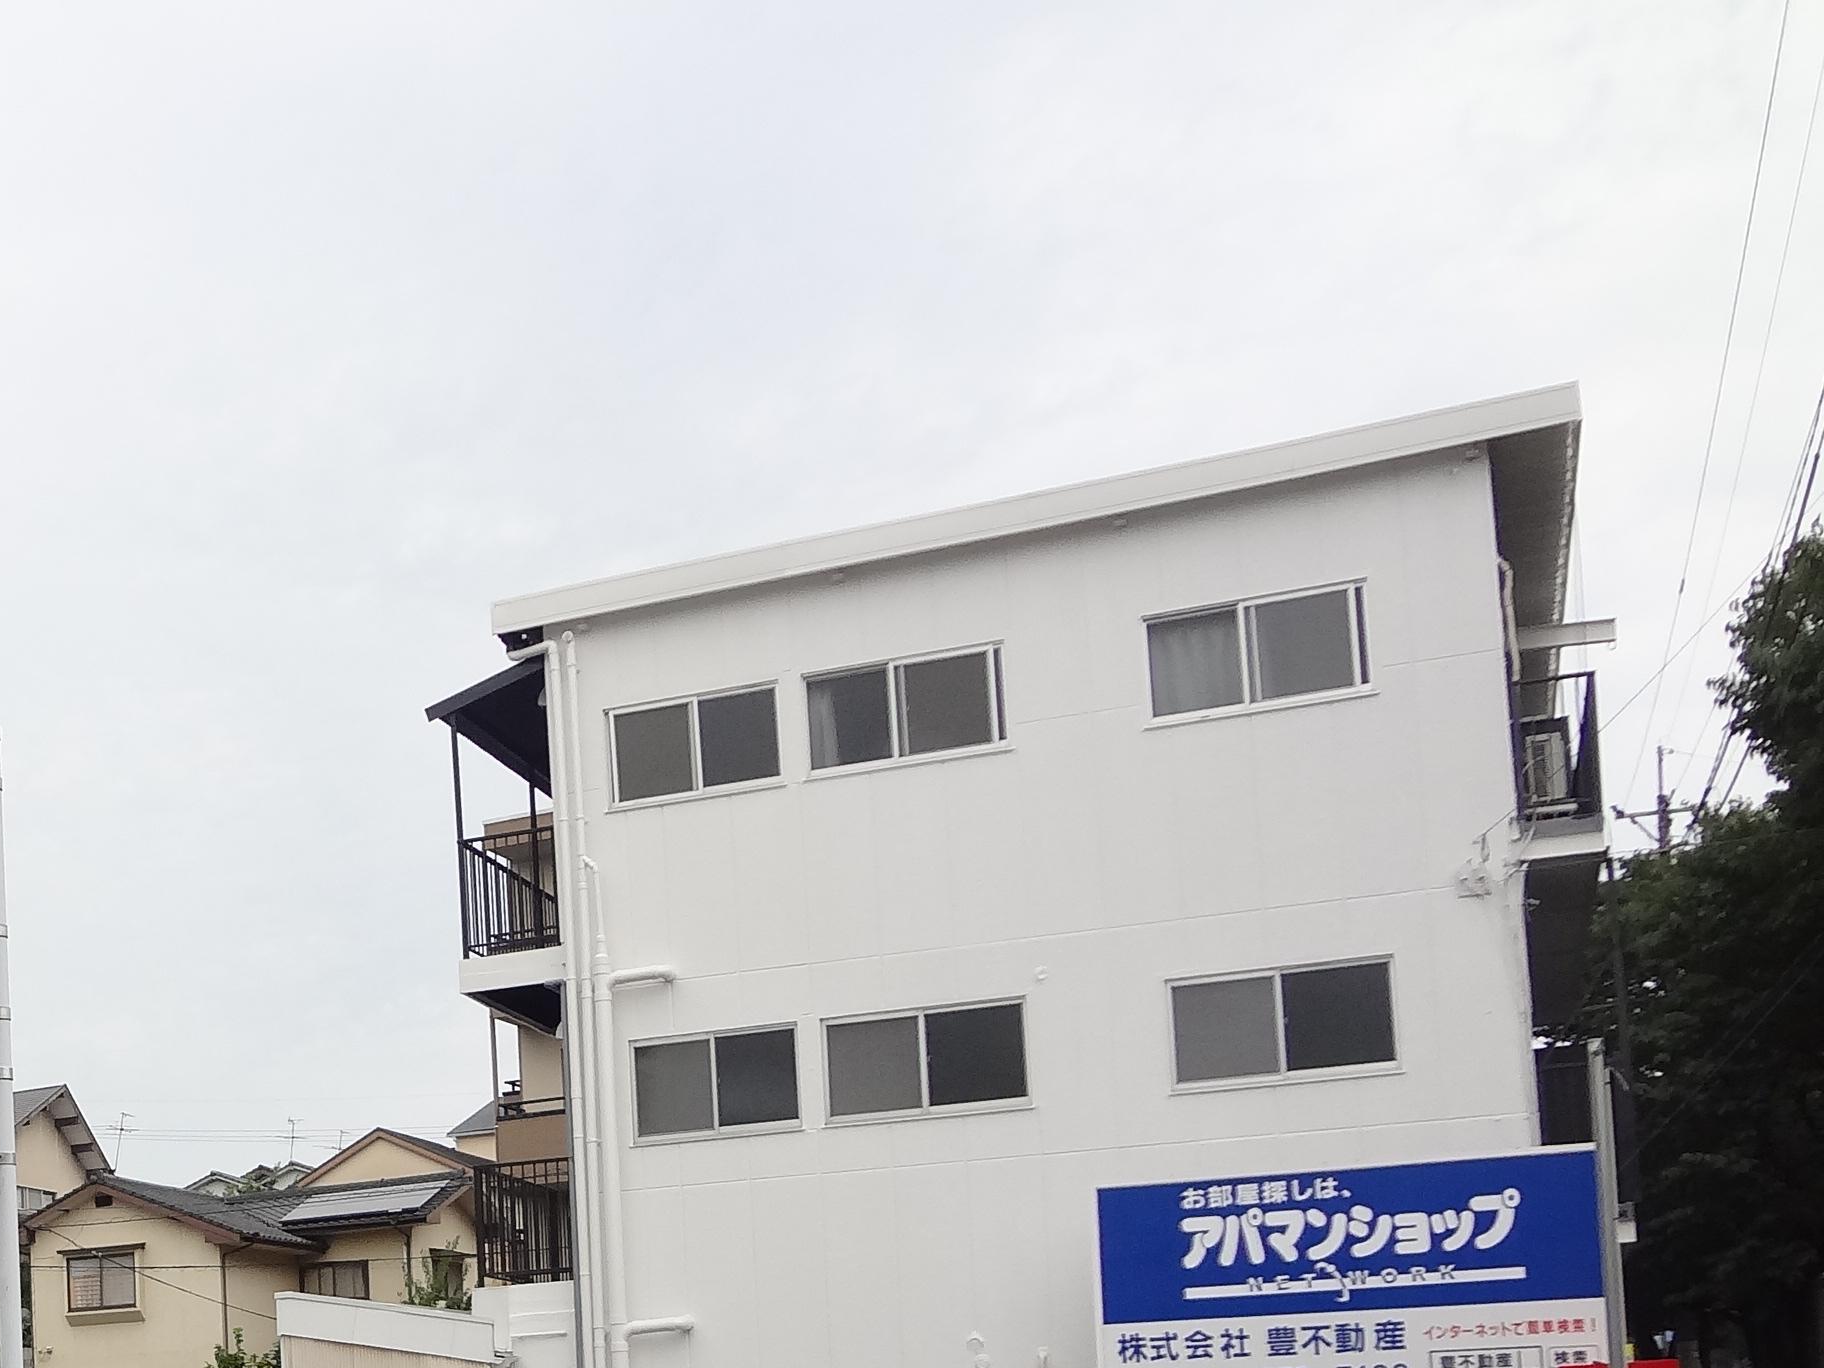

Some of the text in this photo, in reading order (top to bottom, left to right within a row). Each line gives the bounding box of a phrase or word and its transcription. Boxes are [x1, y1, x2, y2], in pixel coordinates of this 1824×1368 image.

[1178, 1187, 1522, 1270] アパマンショップ
[1117, 1319, 1407, 1364] 株式会社 豊不動産
